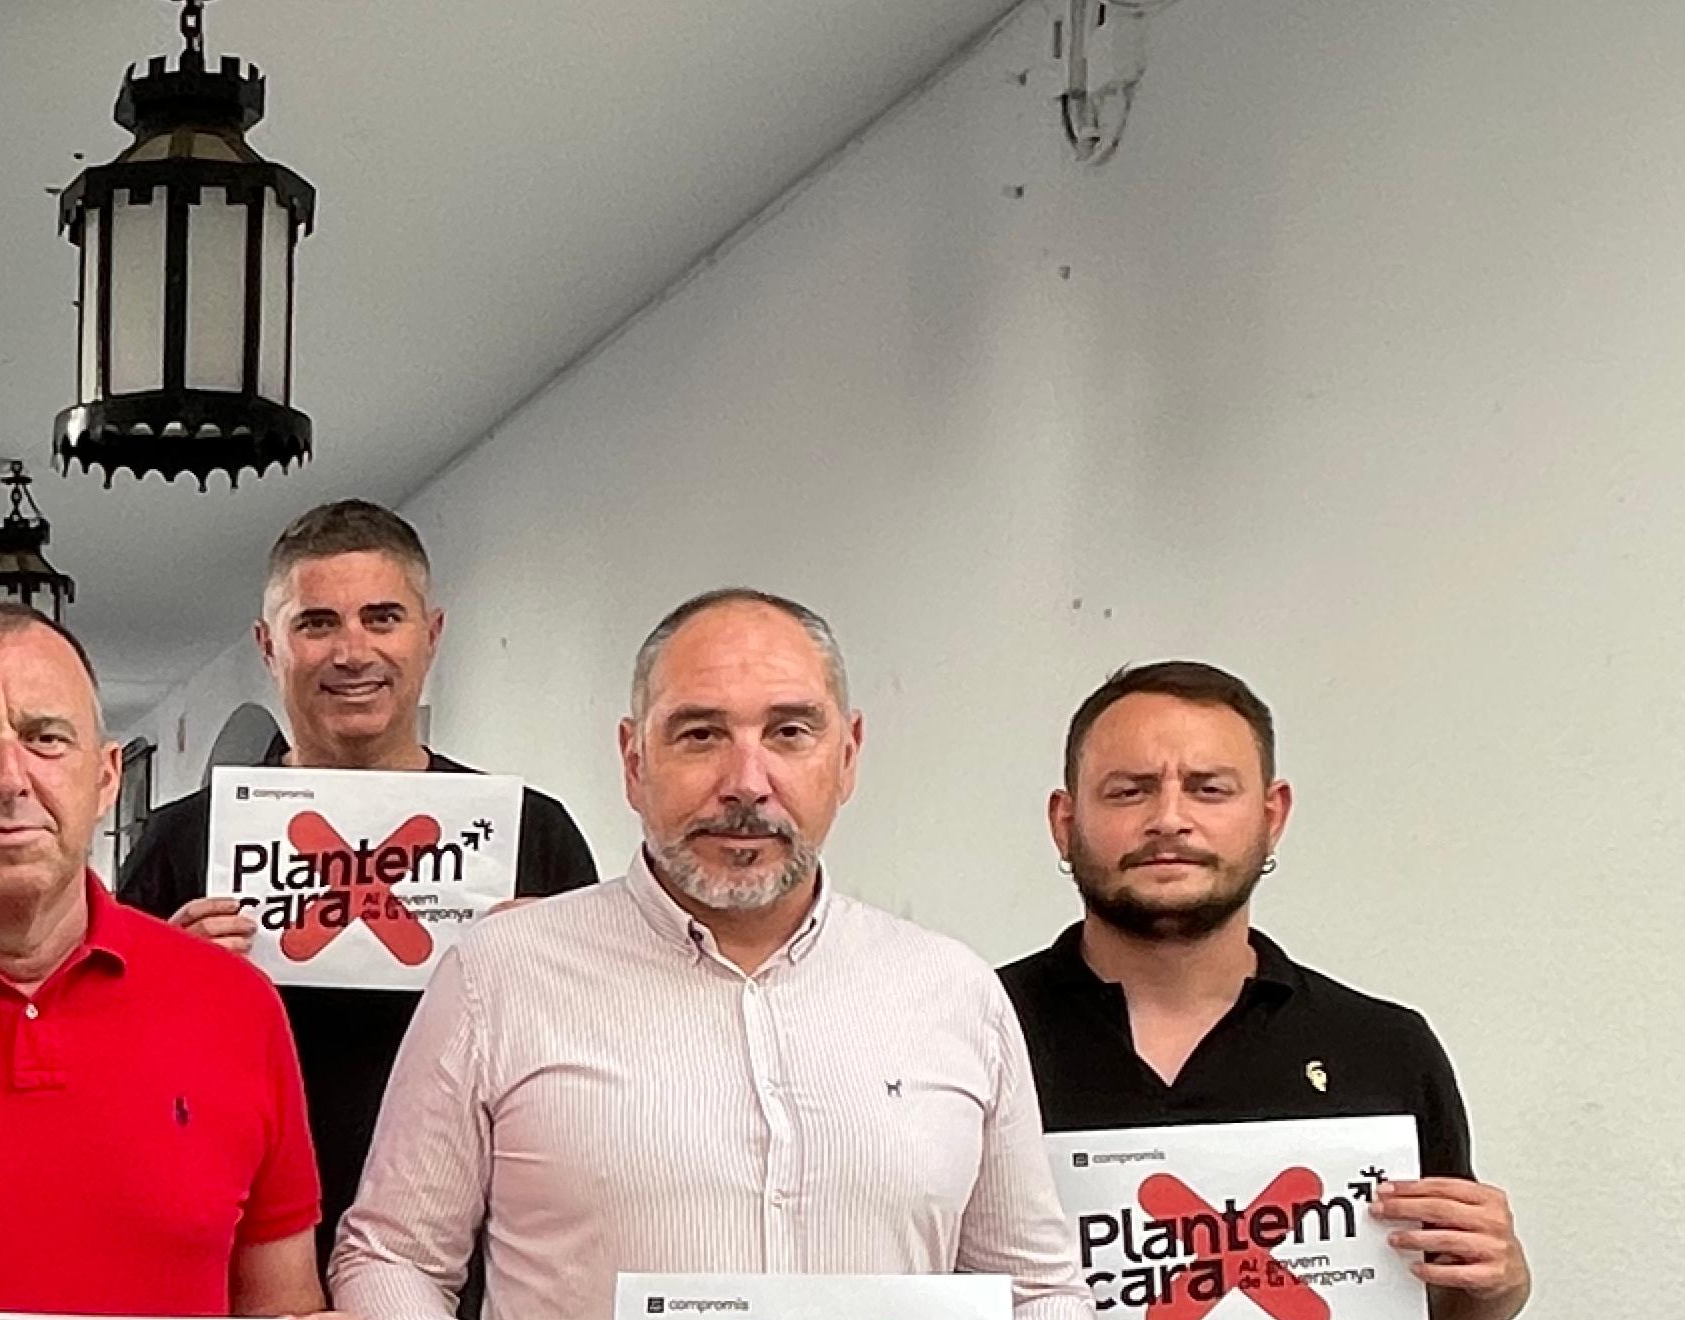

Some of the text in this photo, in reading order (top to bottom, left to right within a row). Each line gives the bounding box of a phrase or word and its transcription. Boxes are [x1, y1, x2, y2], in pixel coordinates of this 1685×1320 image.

[232, 839, 463, 893] Plantem
[1079, 1196, 1356, 1268] Plantem
[1239, 1257, 1258, 1273] Al
